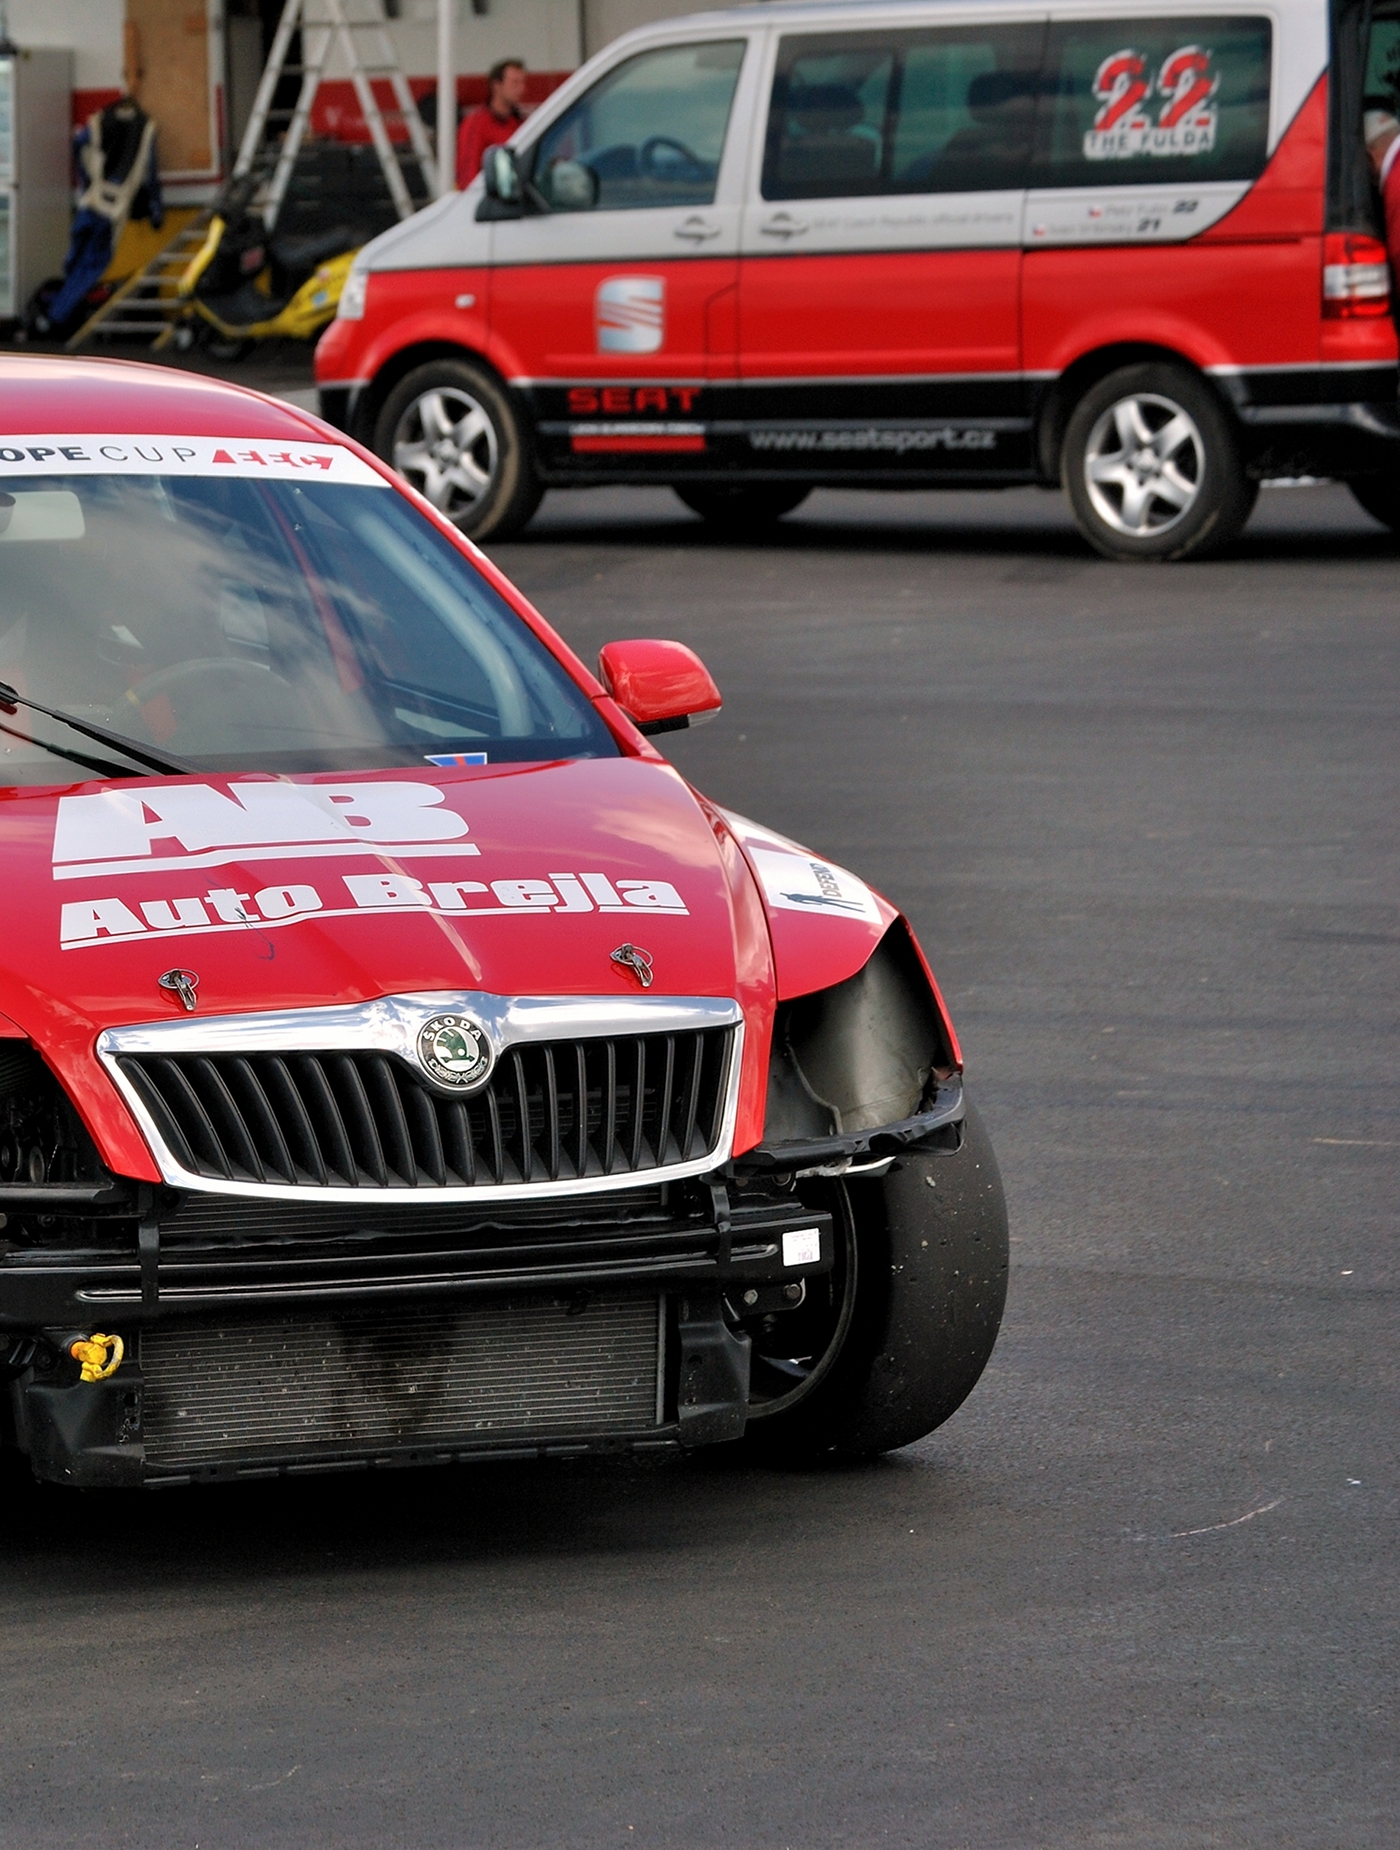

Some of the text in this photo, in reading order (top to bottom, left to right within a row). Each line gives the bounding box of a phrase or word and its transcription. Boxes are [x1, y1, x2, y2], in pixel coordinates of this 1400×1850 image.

[1092, 46, 1220, 131] 22
[1140, 131, 1211, 148] FULDA
[567, 387, 701, 415] SEAT
[99, 445, 197, 463] CUP
[749, 426, 997, 455] www.seatsport.cz
[60, 871, 688, 944] Auto Brejla
